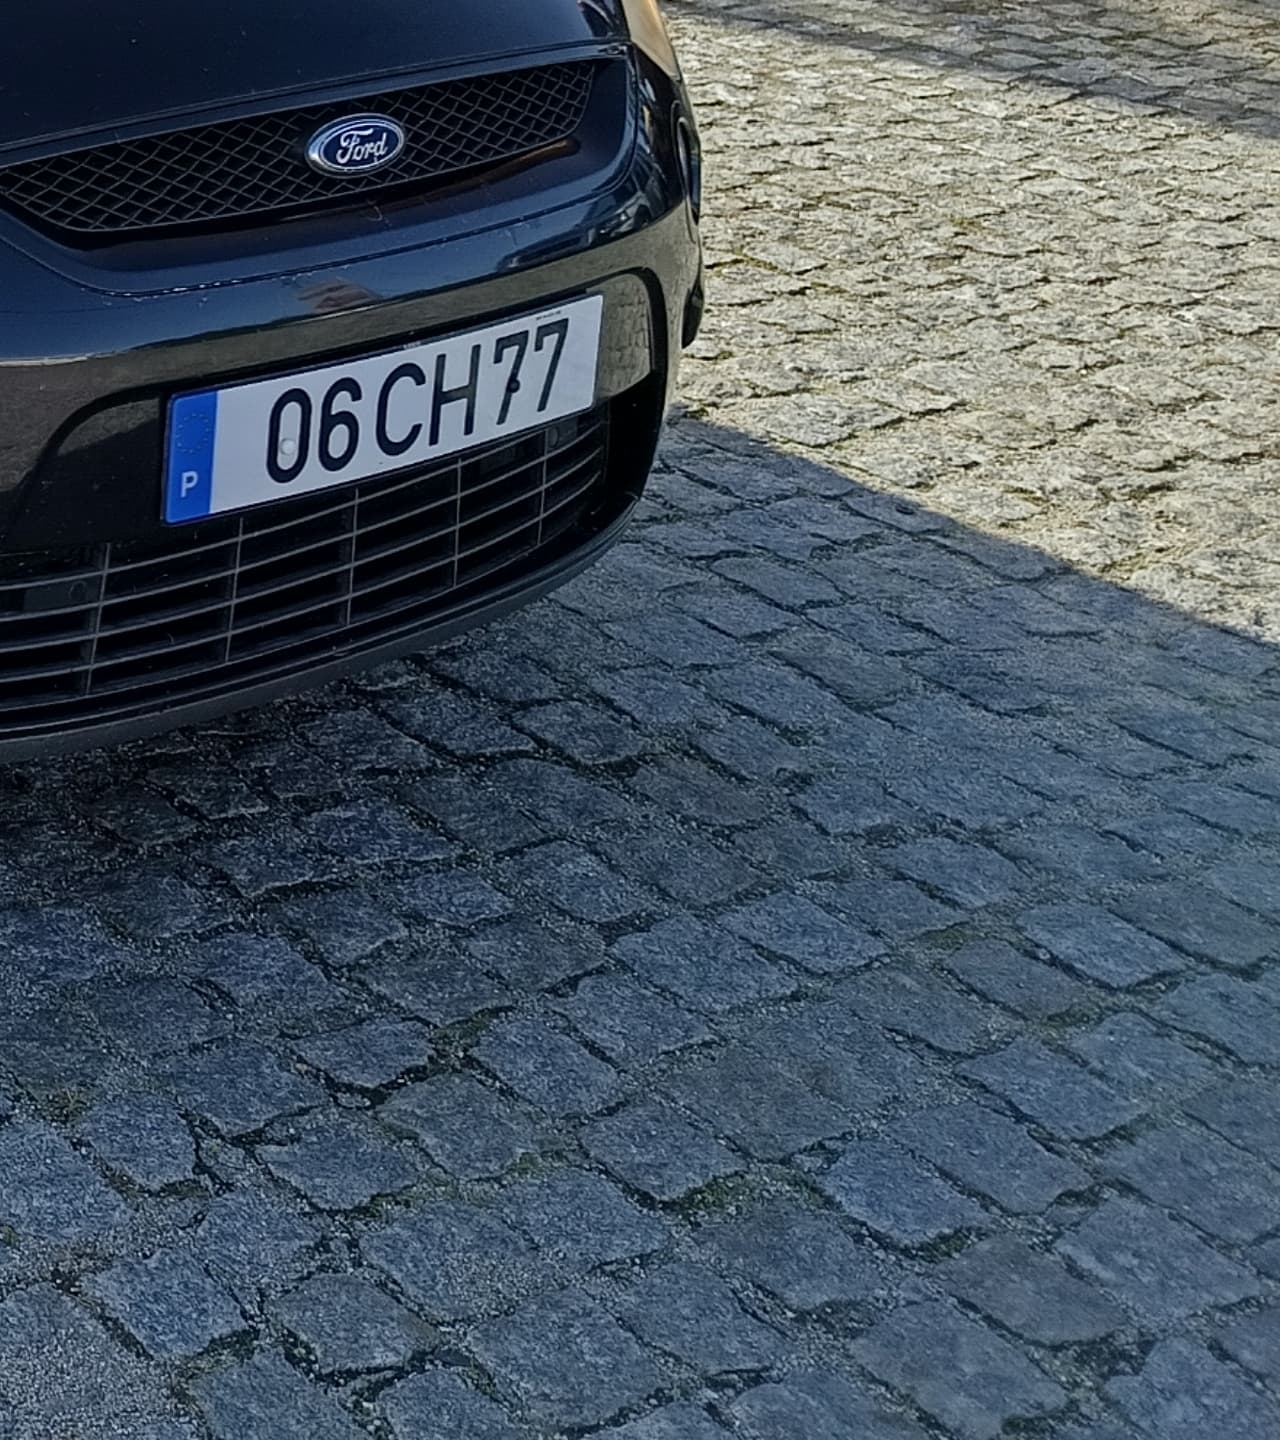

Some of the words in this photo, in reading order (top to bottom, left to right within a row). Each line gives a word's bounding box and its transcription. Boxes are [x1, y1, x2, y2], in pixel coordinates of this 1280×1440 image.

[336, 127, 389, 164] Ford
[266, 318, 569, 484] 06CH77
[180, 470, 199, 498] P
